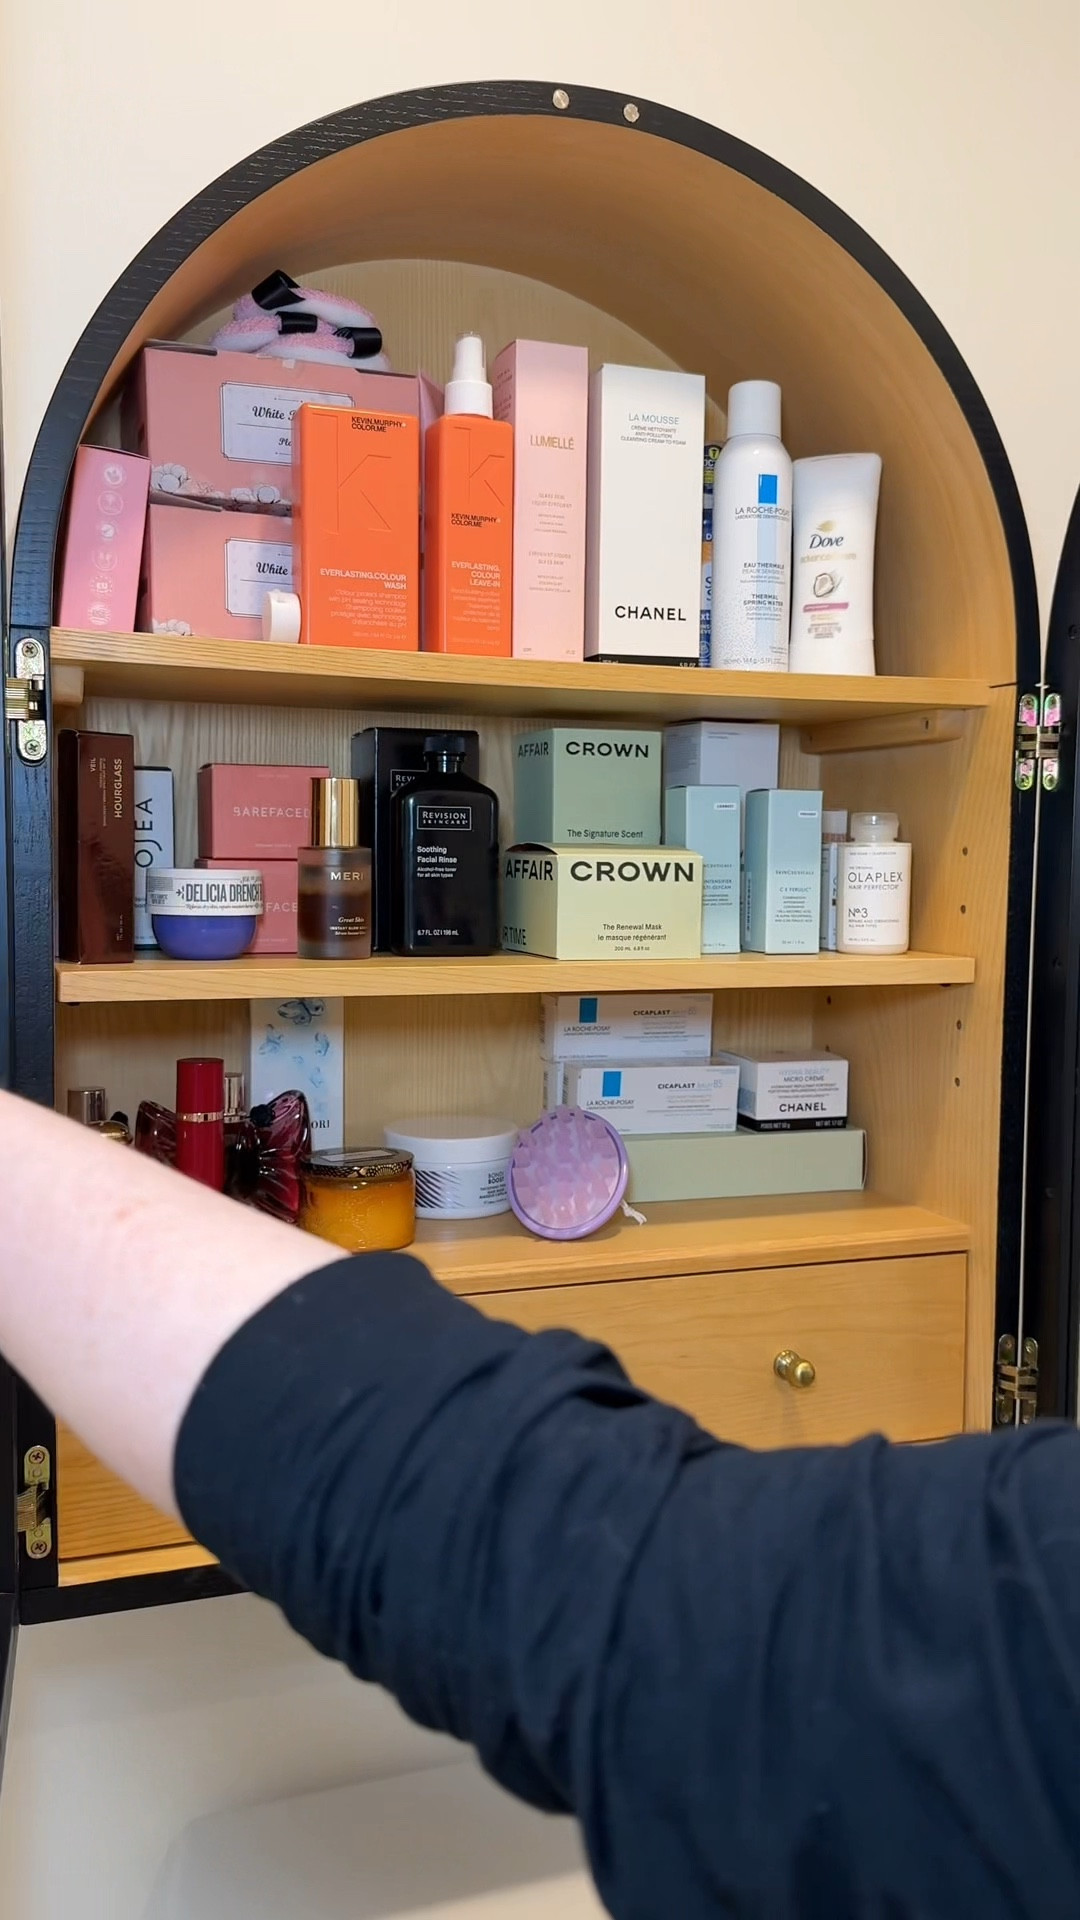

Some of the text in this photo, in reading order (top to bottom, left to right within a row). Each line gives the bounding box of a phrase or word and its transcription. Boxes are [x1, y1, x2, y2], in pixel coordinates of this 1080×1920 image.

[252, 405, 285, 420] White
[628, 413, 680, 425] LA MOUSSE
[735, 507, 745, 515] LA
[809, 533, 844, 549] Dove
[256, 561, 288, 575] White
[470, 571, 500, 580] COLOUR
[384, 581, 407, 590] WASH
[469, 579, 501, 588] LEAVE-IN
[614, 605, 687, 621] CHANEL
[518, 741, 549, 760] AFFAIR
[565, 741, 648, 759] CROWN
[113, 757, 123, 819] HOURGLASS
[422, 811, 467, 820] REVISION
[567, 829, 643, 840] The Signature Scent
[417, 845, 448, 855] Soothing
[417, 855, 458, 864] Facial Rinse
[505, 859, 553, 881] AFFAIR
[570, 861, 693, 882] CROWN
[847, 871, 903, 883] OLAPLEX
[603, 923, 662, 931] The Renewal Mask
[597, 933, 667, 943] le masque régénérant
[657, 1082, 696, 1090] CICAPLAST
[778, 1102, 827, 1113] CHANEL
